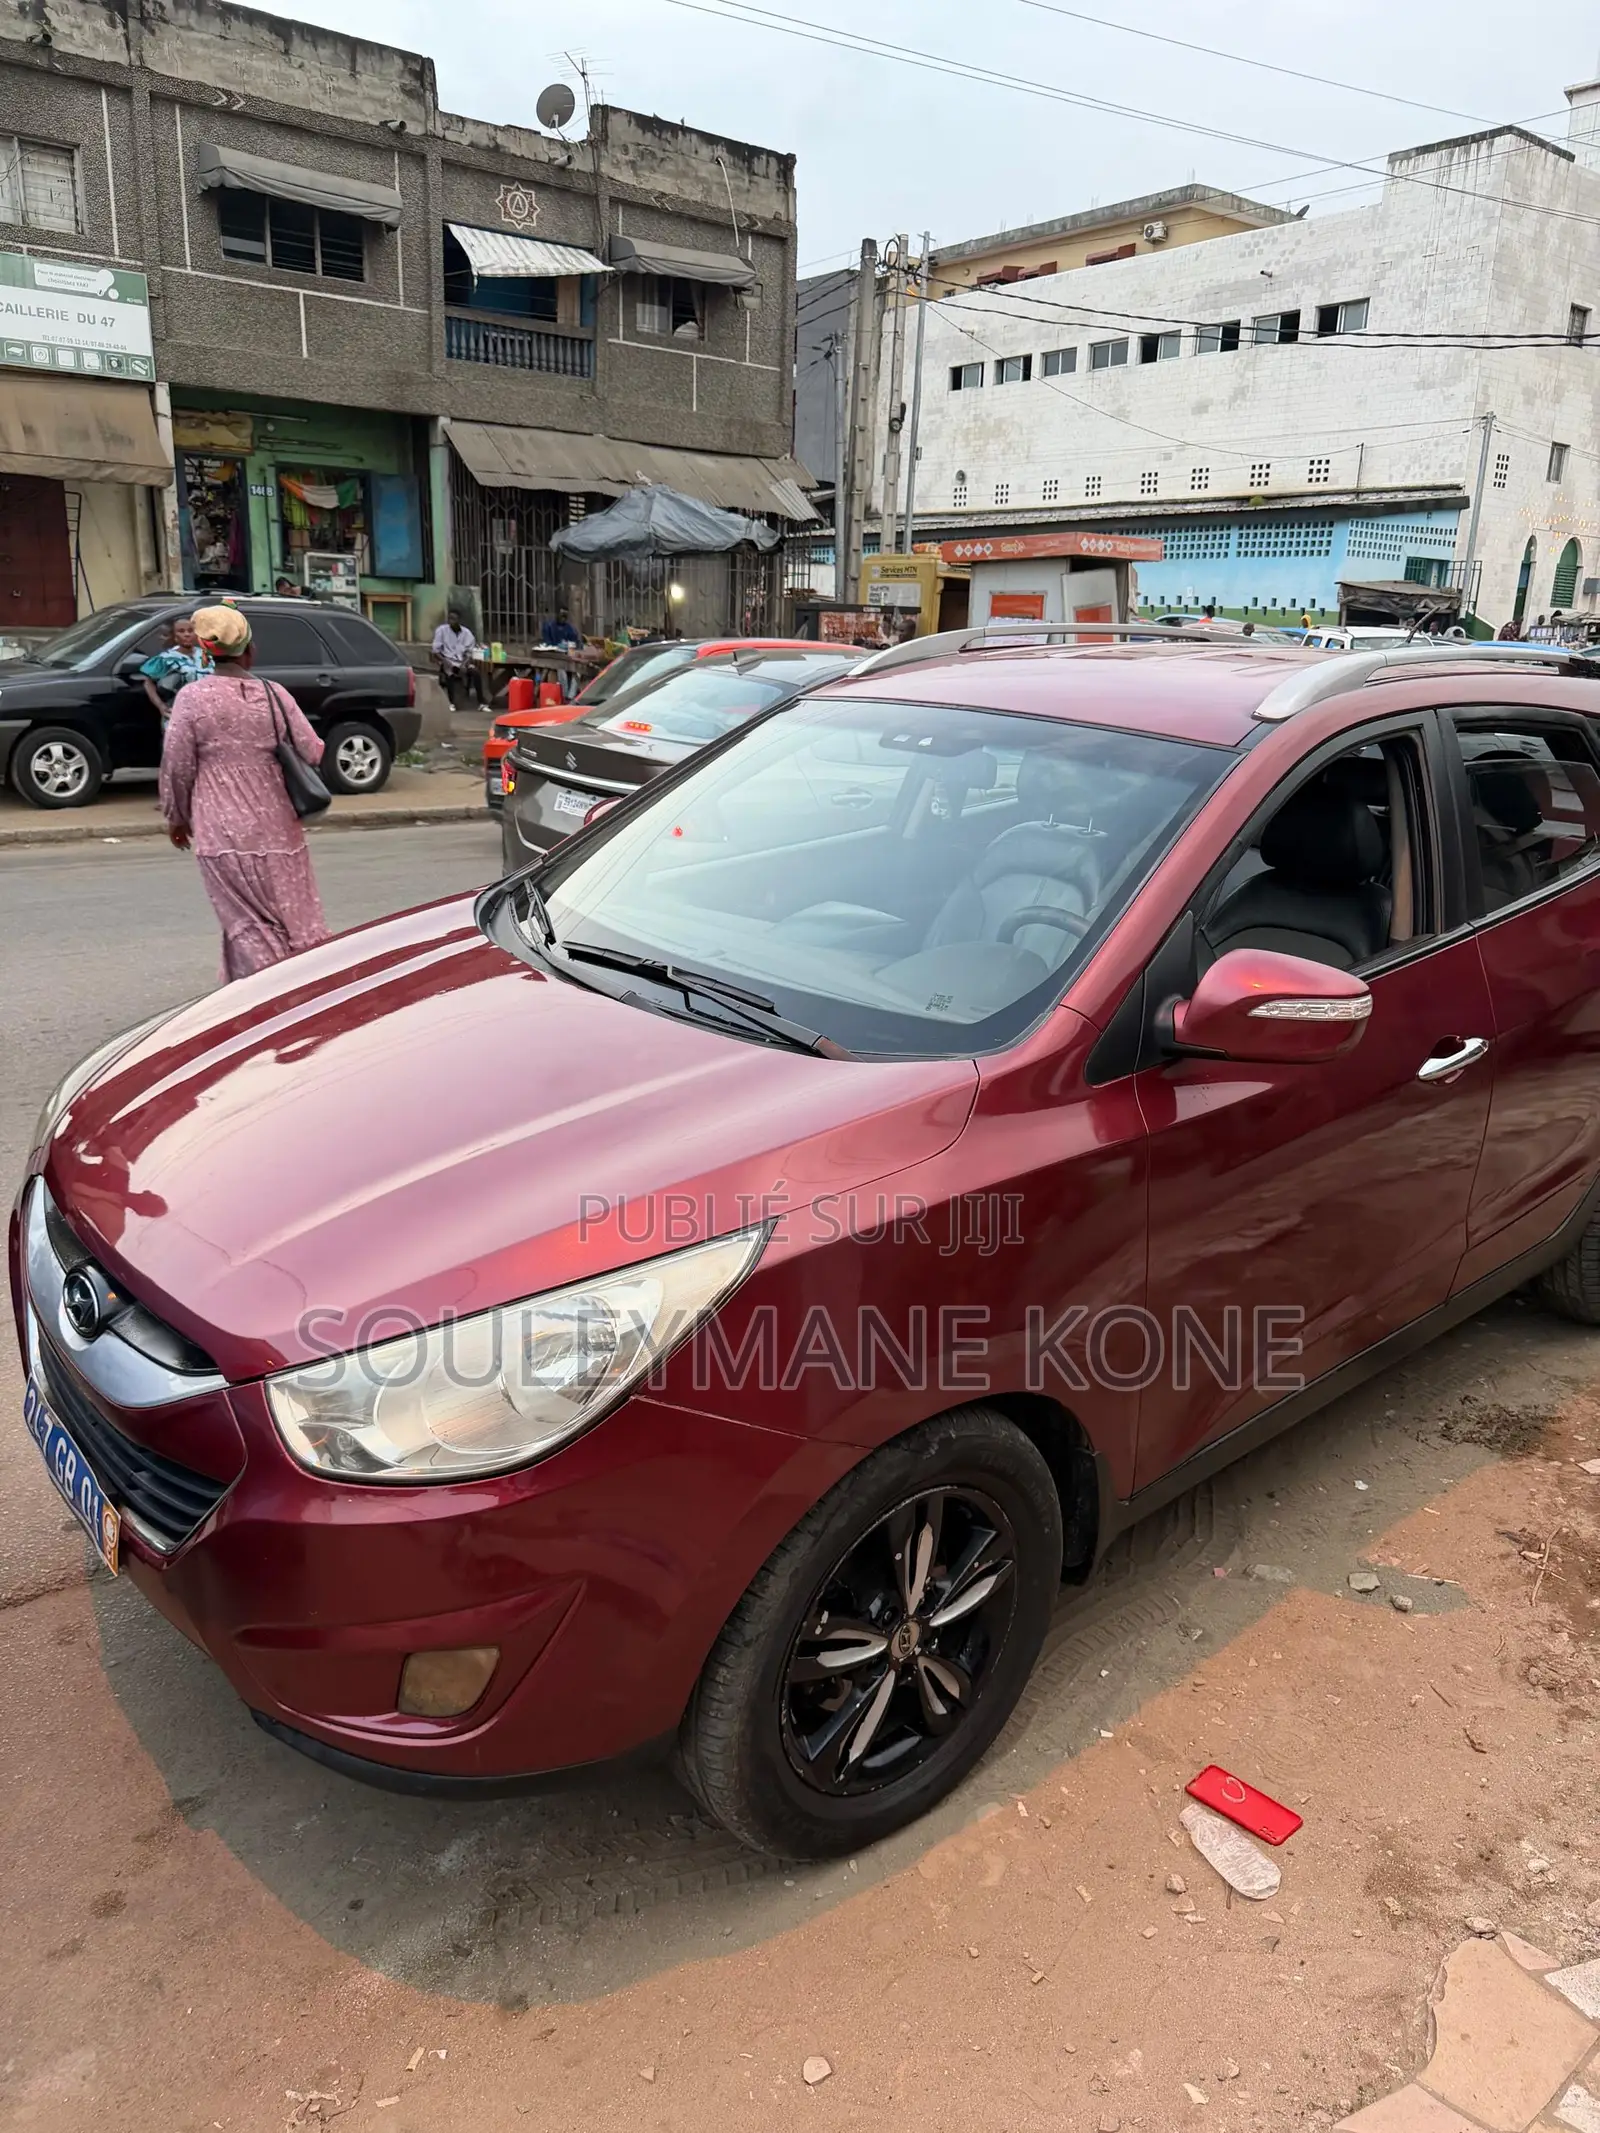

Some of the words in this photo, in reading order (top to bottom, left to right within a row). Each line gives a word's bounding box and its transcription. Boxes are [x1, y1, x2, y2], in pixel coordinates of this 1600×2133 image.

[77, 312, 96, 325] DU
[100, 316, 116, 327] 47
[881, 566, 903, 574] Services
[904, 566, 918, 574] MTN
[55, 1436, 77, 1501] GB
[80, 1475, 100, 1541] 01
